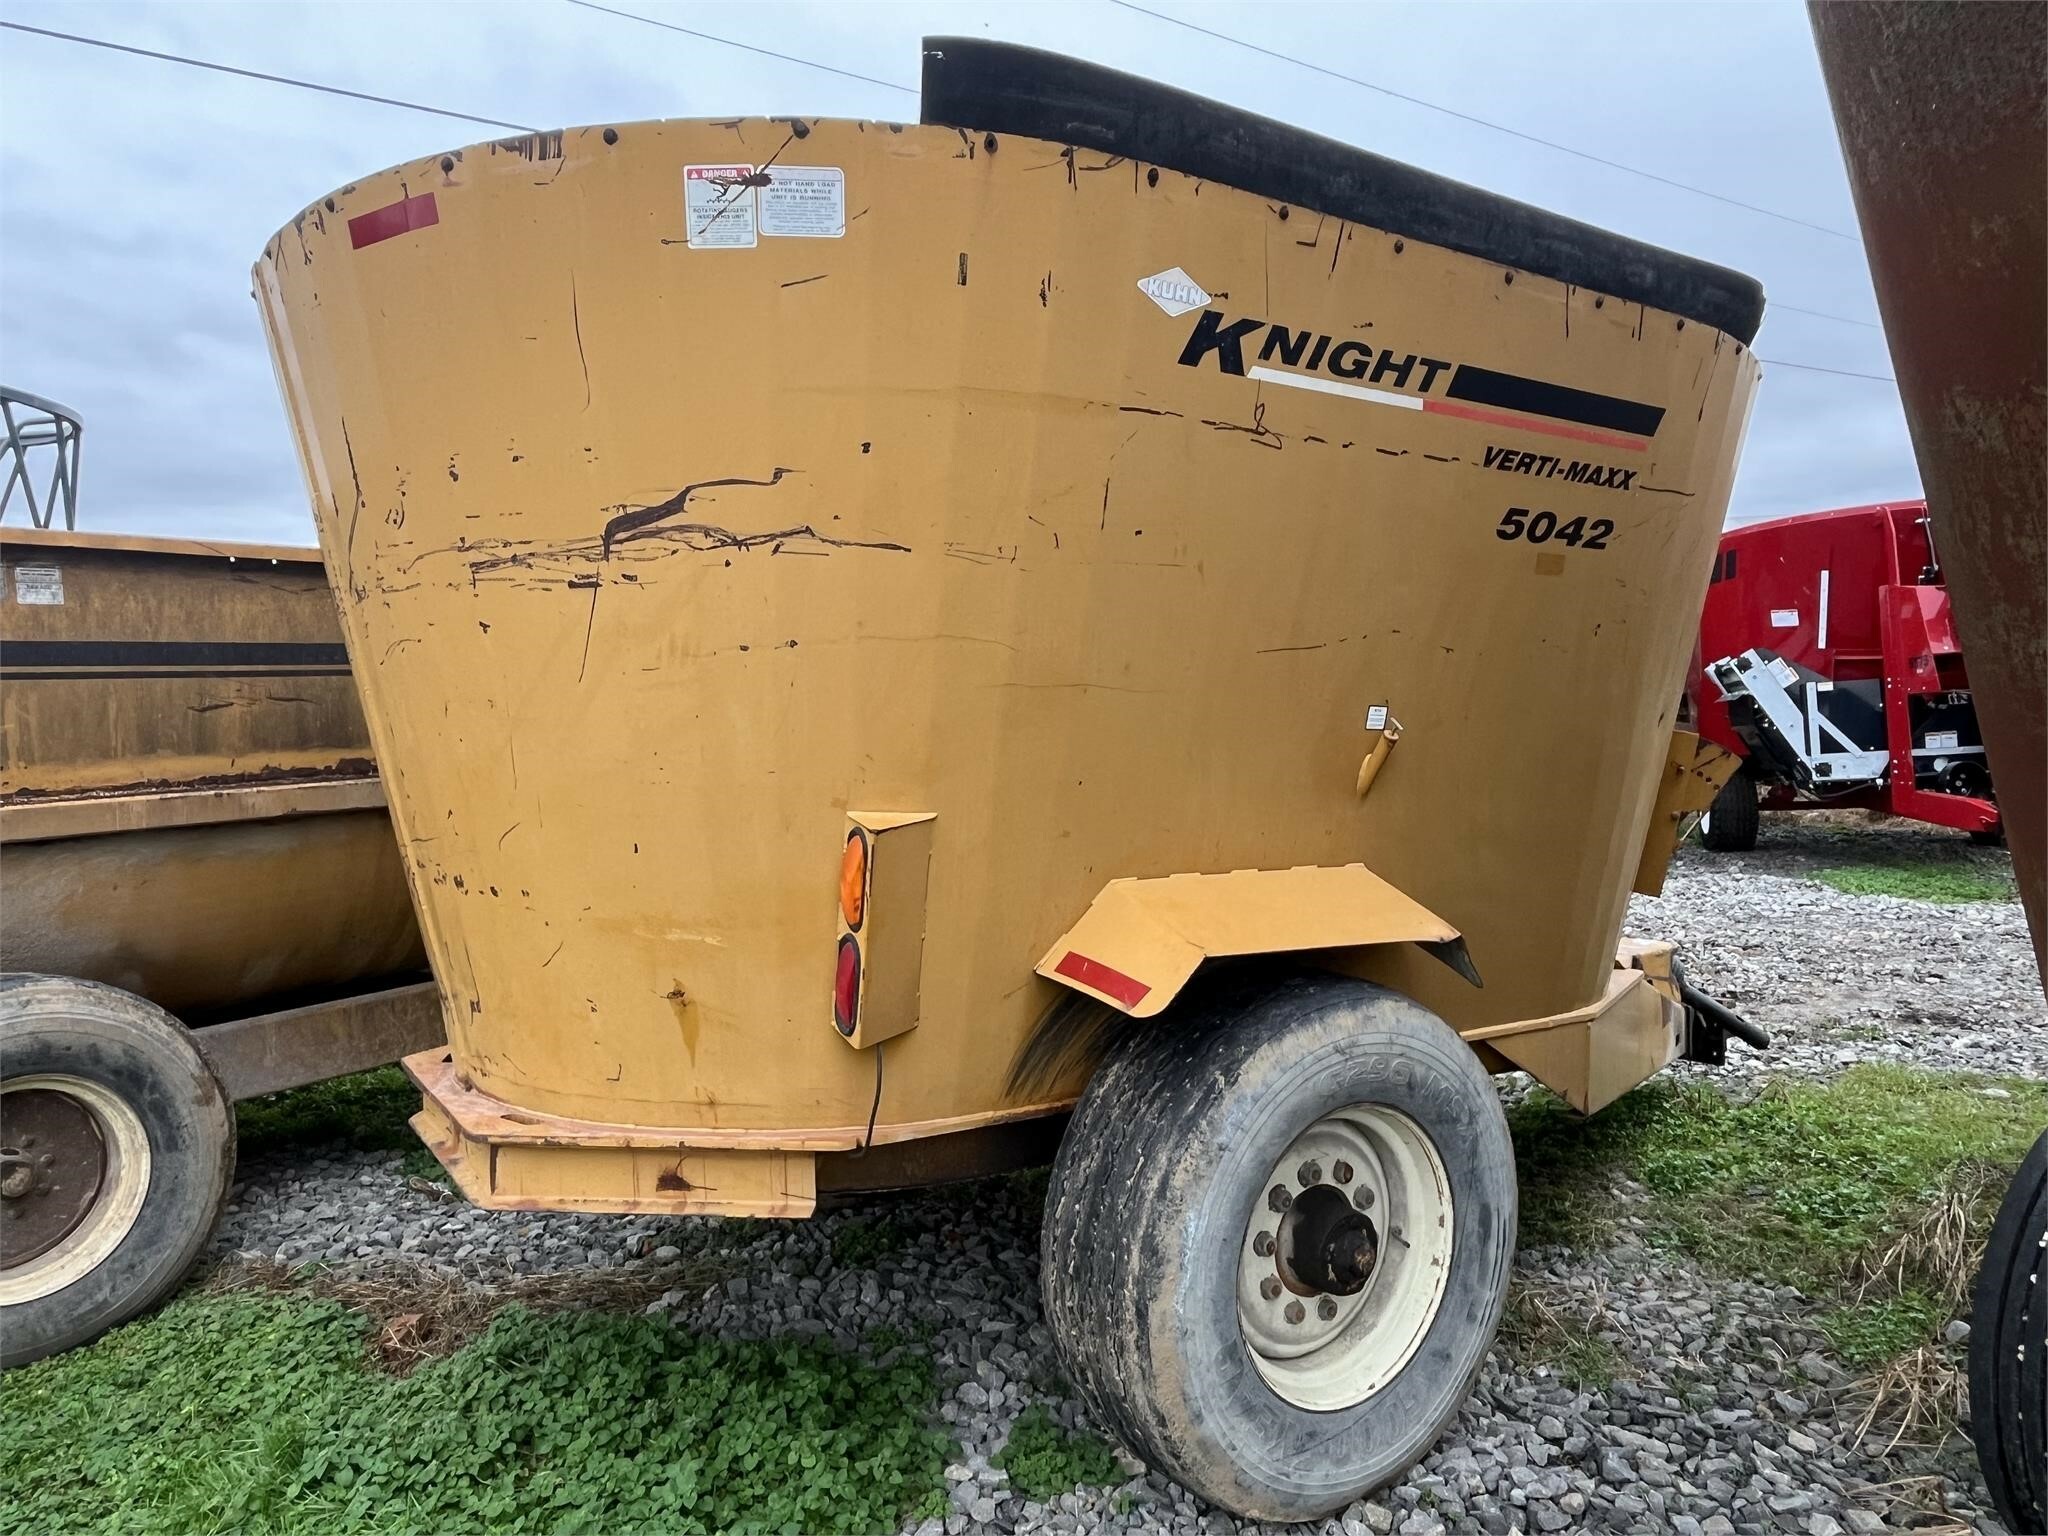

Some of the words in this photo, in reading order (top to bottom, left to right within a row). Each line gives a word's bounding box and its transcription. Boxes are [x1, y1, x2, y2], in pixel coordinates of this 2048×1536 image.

[702, 168, 738, 178] DANGER
[1148, 279, 1203, 306] KUHN
[1177, 309, 1453, 393] KNIGHT
[1483, 446, 1638, 491] VERTI-MAXX
[1496, 507, 1615, 550] 5042
